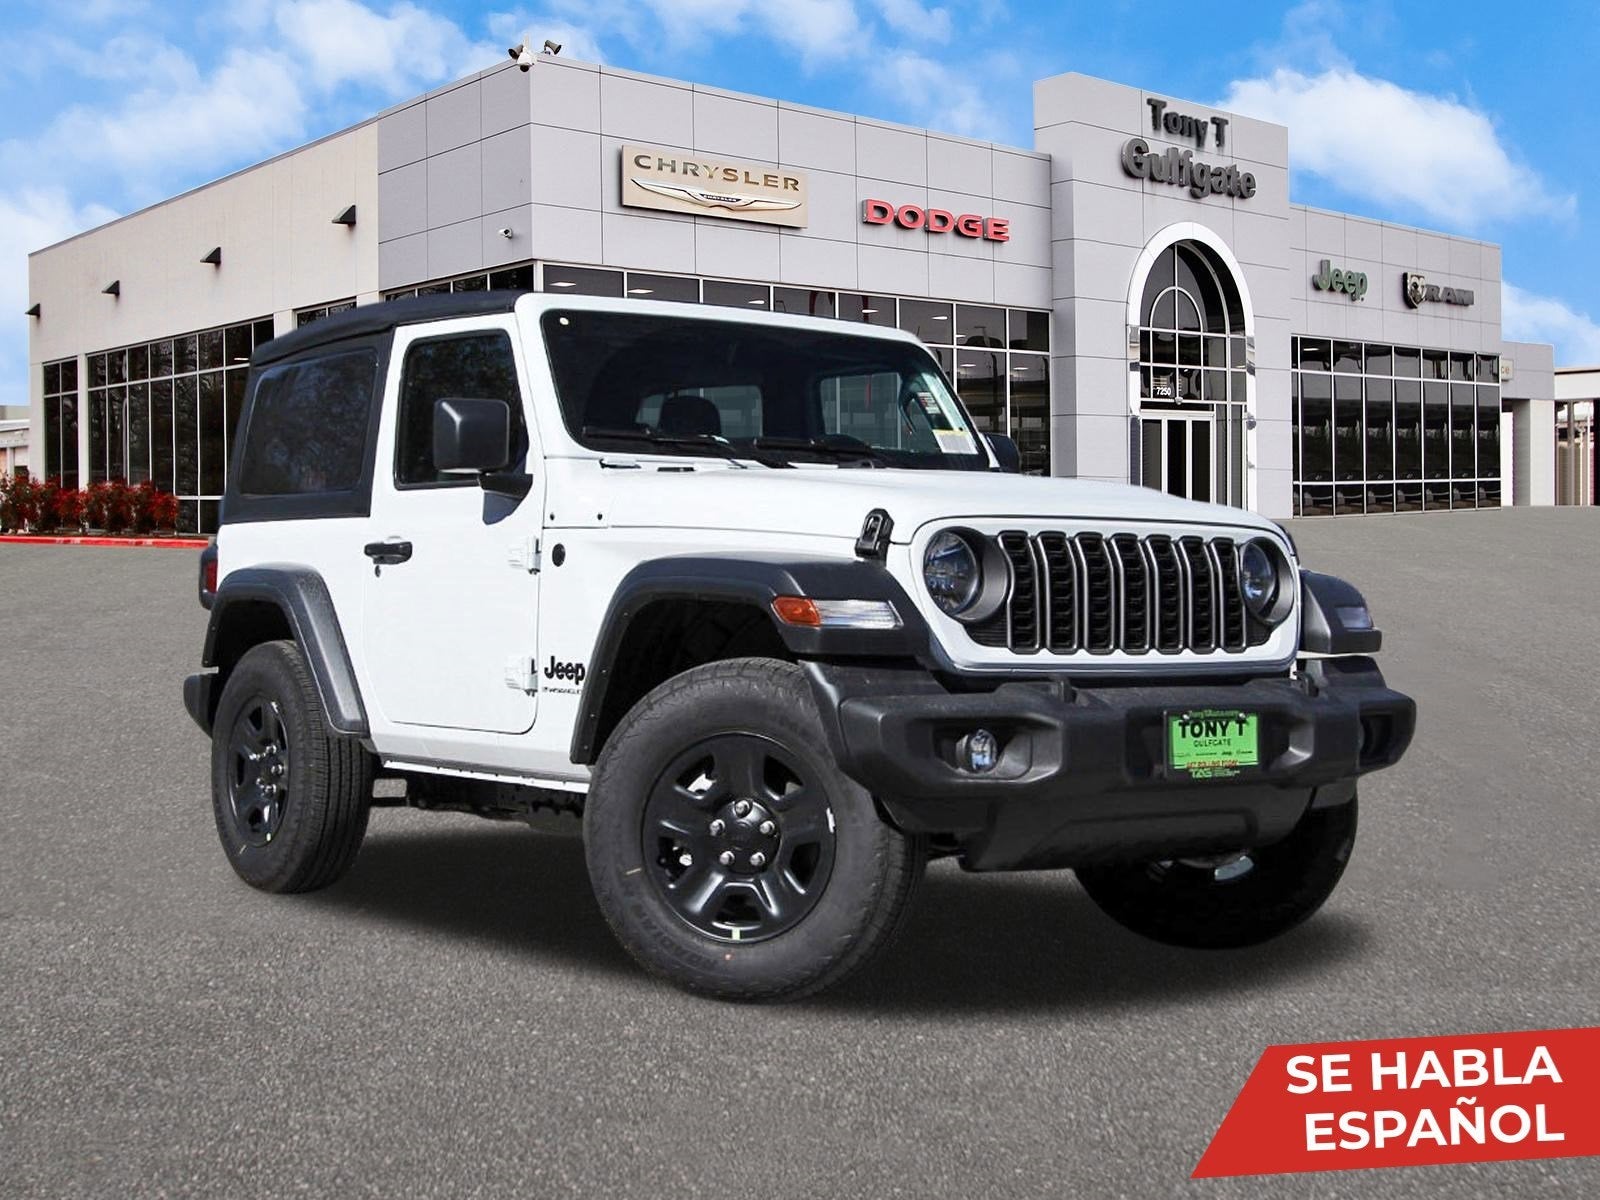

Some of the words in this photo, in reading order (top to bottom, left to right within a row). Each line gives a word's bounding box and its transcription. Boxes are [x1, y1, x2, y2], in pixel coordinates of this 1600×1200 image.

[1147, 98, 1208, 148] Tony
[1211, 116, 1229, 147] T
[633, 154, 800, 192] CHRYSLER
[1121, 137, 1256, 199] Gulfgate
[862, 198, 1011, 242] DODGE
[1312, 259, 1368, 302] Jeep
[1425, 284, 1475, 306] RAM
[1156, 387, 1172, 396] 7250
[544, 655, 586, 685] Jeep
[1178, 719, 1230, 738] TONY
[1235, 718, 1247, 736] T
